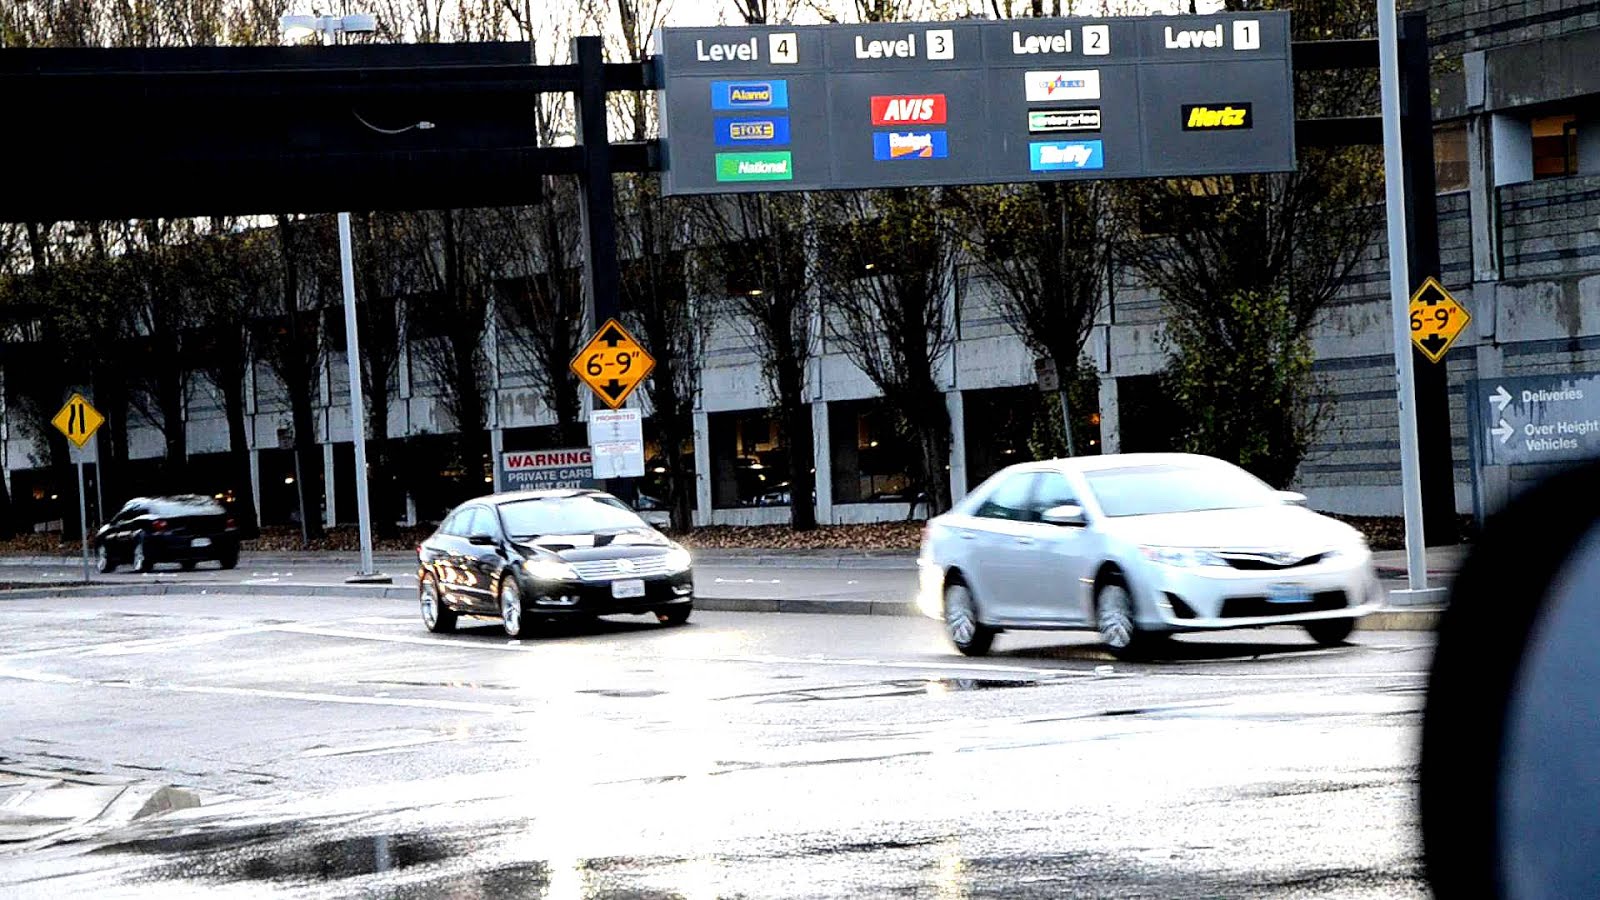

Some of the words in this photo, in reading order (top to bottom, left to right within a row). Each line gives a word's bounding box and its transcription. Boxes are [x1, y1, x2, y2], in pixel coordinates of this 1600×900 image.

[1012, 29, 1072, 54] Level
[1091, 31, 1101, 49] 2
[1164, 24, 1223, 49] Level
[1243, 26, 1250, 44] 1
[697, 36, 758, 61] Level
[776, 38, 789, 58] 4
[855, 33, 916, 59] Level
[934, 35, 946, 53] 3
[731, 89, 769, 101] Alamo
[883, 98, 935, 121] AVIS
[1187, 106, 1246, 127] Hertz
[740, 125, 761, 137] FOX
[889, 132, 933, 150] Budget
[738, 160, 787, 174] National
[1410, 307, 1456, 331] 6'-9"
[586, 351, 640, 377] 6'-9"
[1521, 388, 1584, 403] Deliveries
[1524, 423, 1555, 436] Over
[1556, 419, 1599, 435] Height
[1525, 438, 1578, 452] Vehicles
[508, 452, 592, 468] WARNING
[508, 470, 558, 483] PRIVATE
[560, 468, 592, 480] CARS
[520, 481, 554, 491] MUST
[556, 480, 582, 490] EXIT
